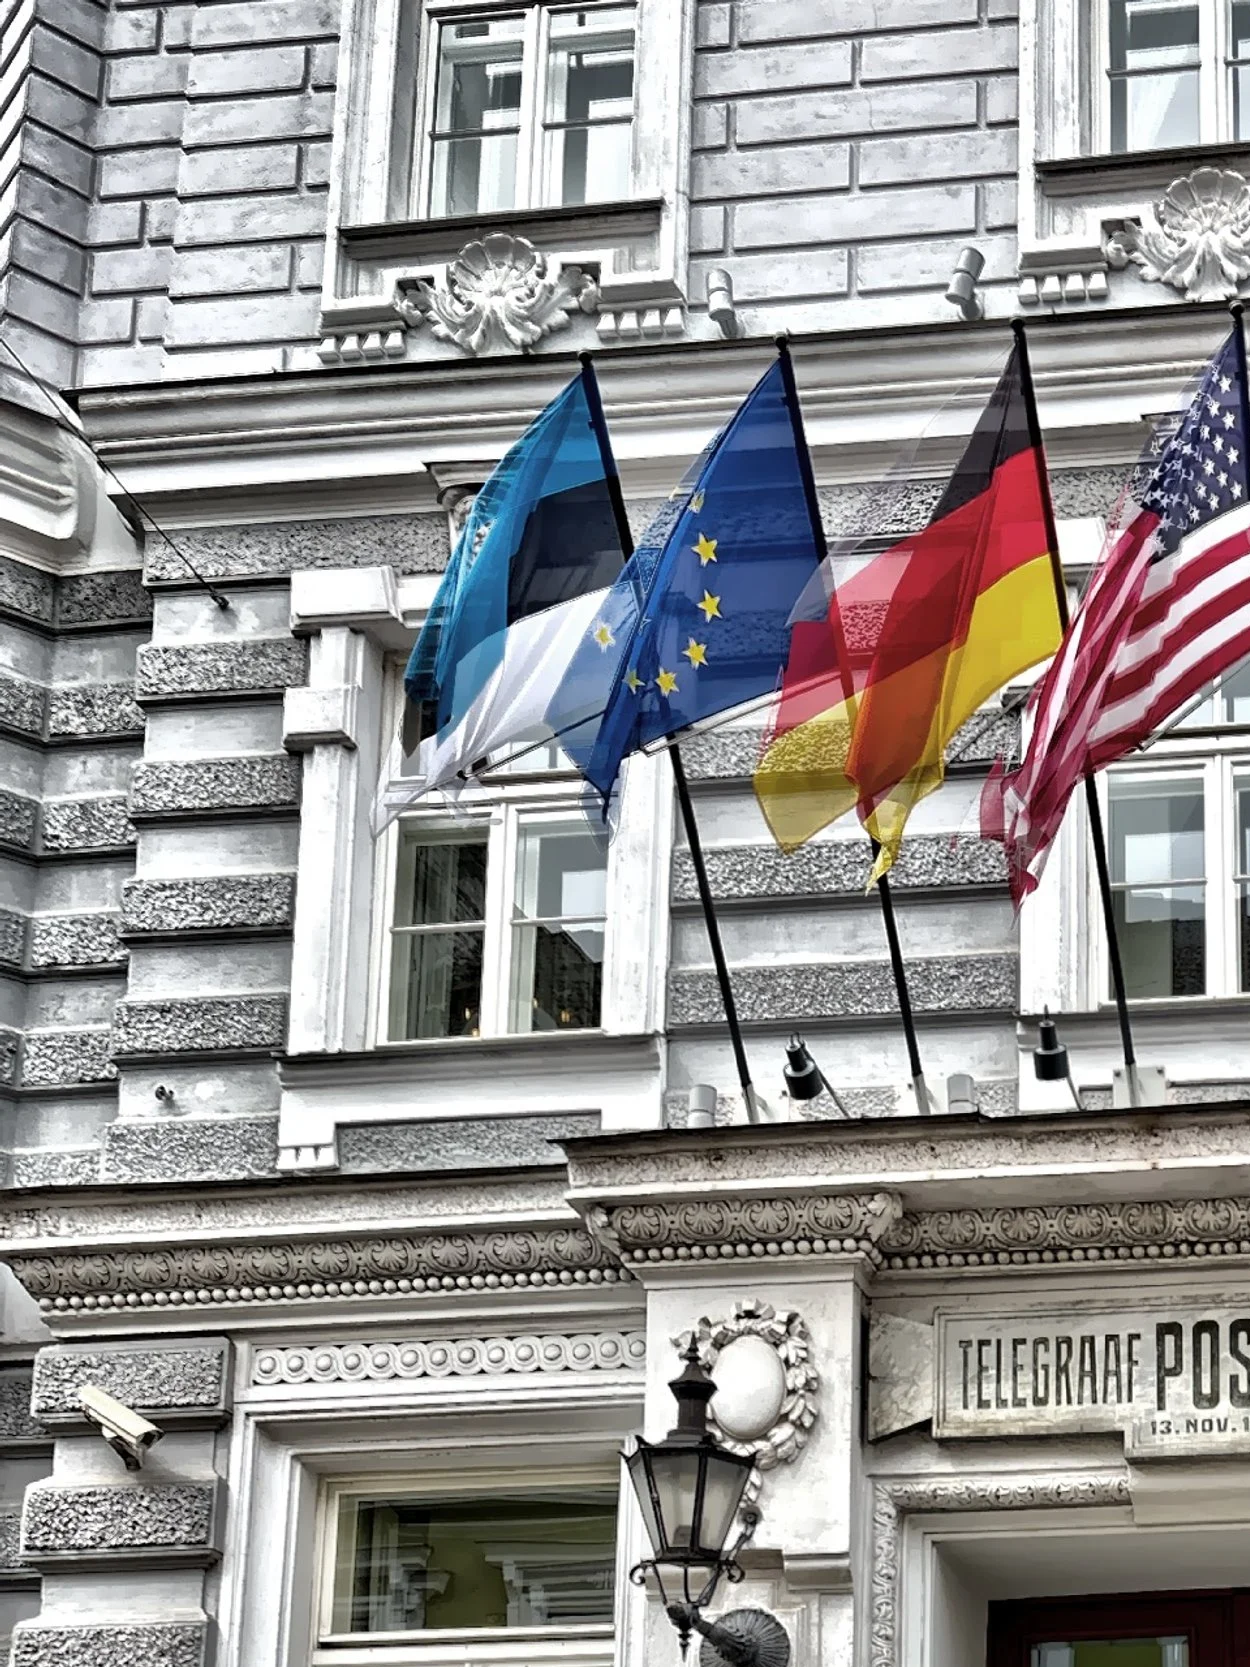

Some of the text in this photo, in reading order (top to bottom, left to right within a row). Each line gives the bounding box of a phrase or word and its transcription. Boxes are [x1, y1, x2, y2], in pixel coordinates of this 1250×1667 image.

[958, 1333, 1141, 1410] TELEGRAAF
[1151, 1419, 1180, 1436] 13.
[1186, 1417, 1237, 1434] NOV.
